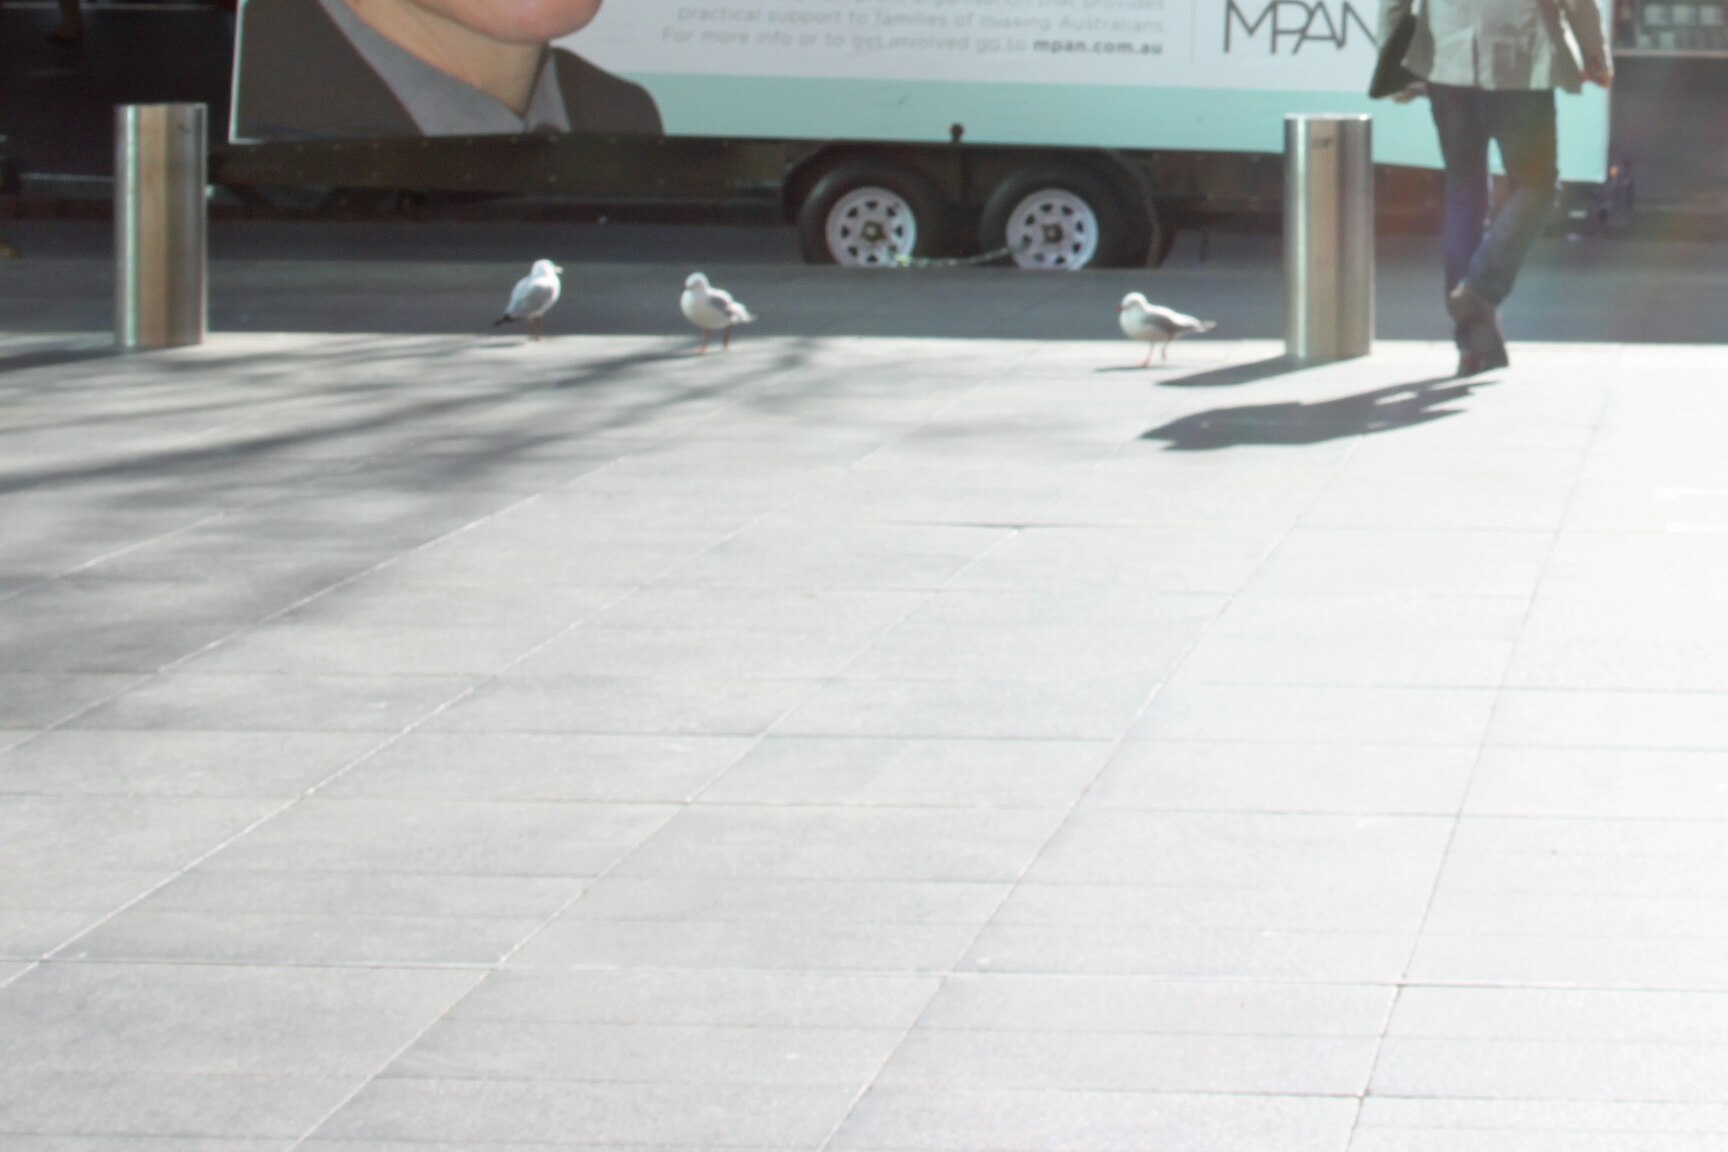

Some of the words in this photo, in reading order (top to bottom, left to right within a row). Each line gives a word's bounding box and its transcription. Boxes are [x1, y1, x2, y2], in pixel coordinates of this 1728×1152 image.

[677, 7, 762, 23] practical
[767, 10, 842, 26] support
[847, 10, 869, 26] to
[953, 11, 974, 28] of
[661, 25, 694, 43] For
[701, 29, 750, 46] more
[798, 33, 818, 47] or
[824, 33, 846, 49] to
[975, 38, 1001, 56] go
[1006, 37, 1027, 53] to
[1032, 39, 1164, 56] mpan.com.au
